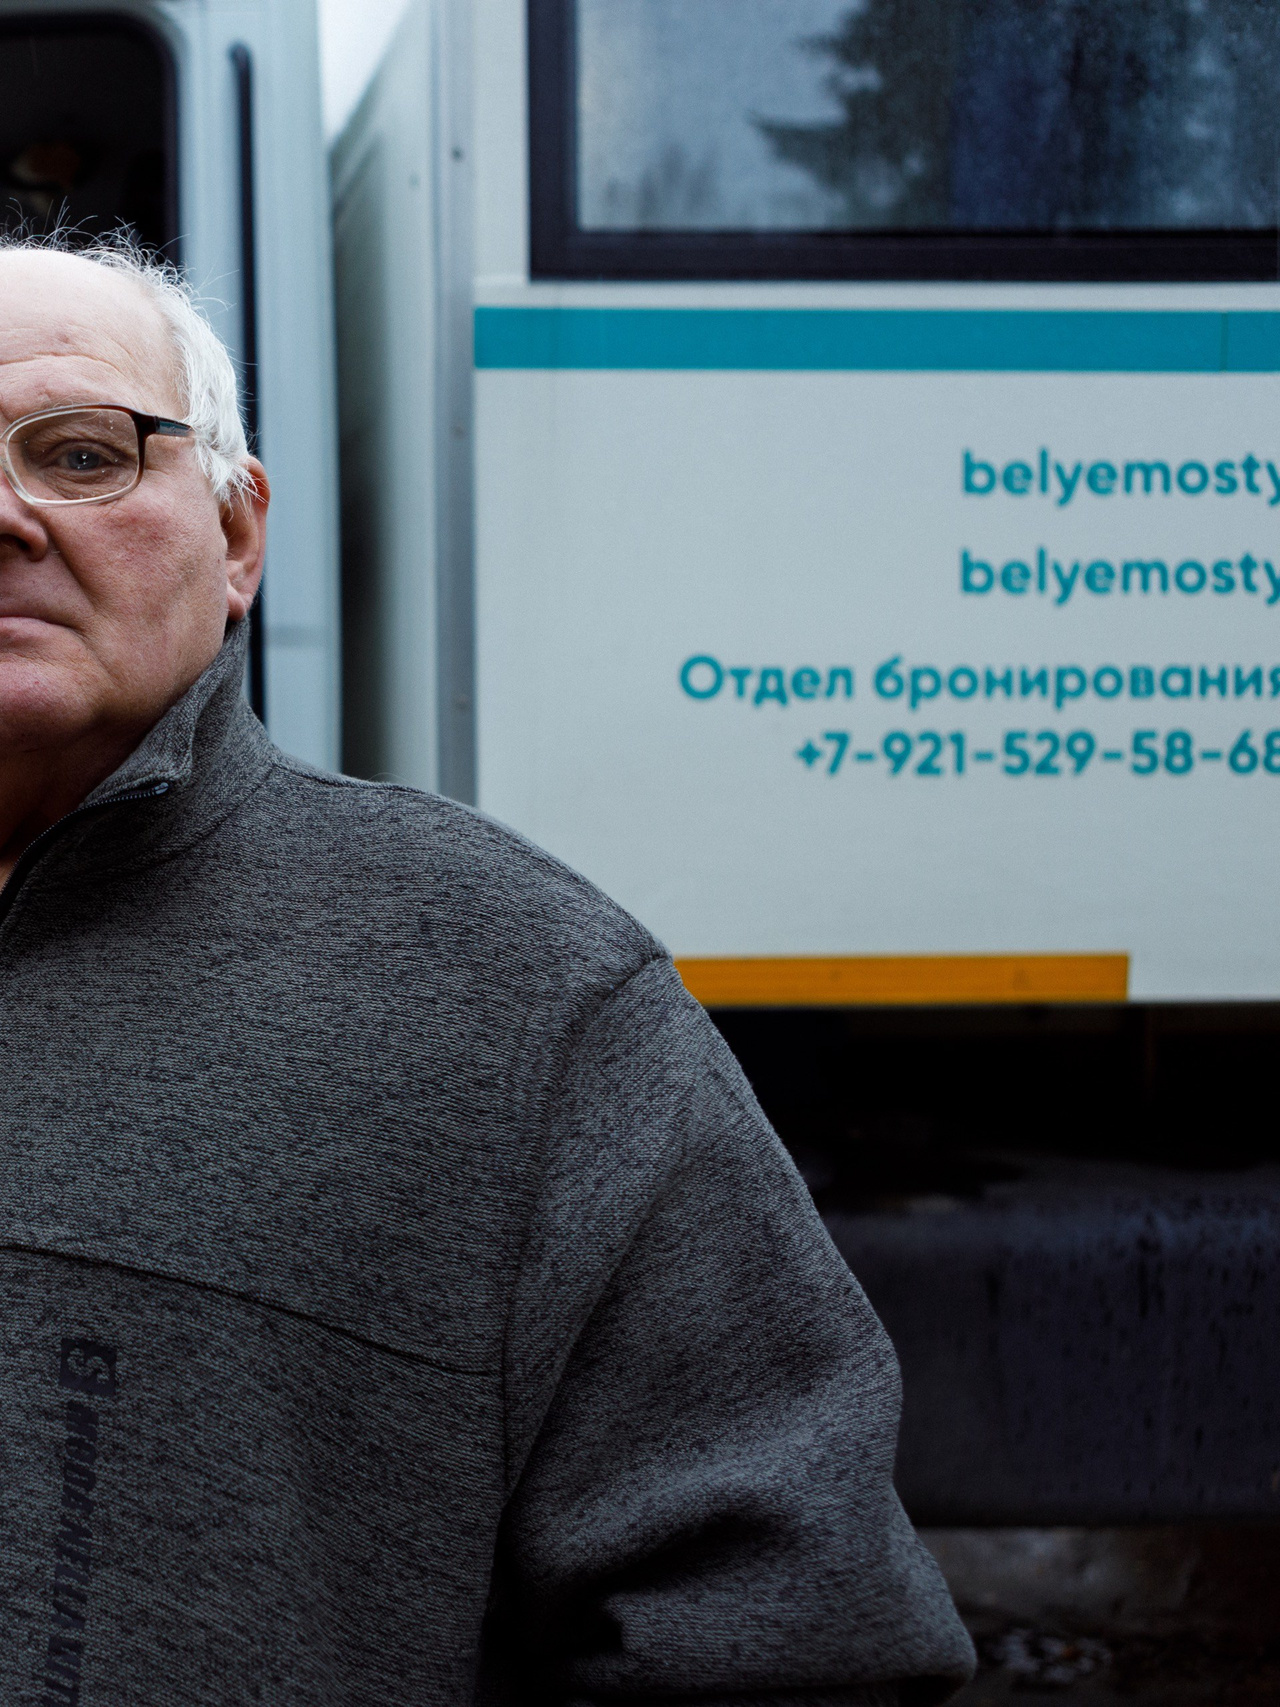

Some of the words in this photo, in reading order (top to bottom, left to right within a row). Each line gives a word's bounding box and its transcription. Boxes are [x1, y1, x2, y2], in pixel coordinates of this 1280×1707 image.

[962, 447, 1280, 507] belyemosty
[960, 546, 1280, 606] belyemosty
[679, 654, 855, 708] Отдел
[795, 729, 1280, 778] +7-921-529-58-68
